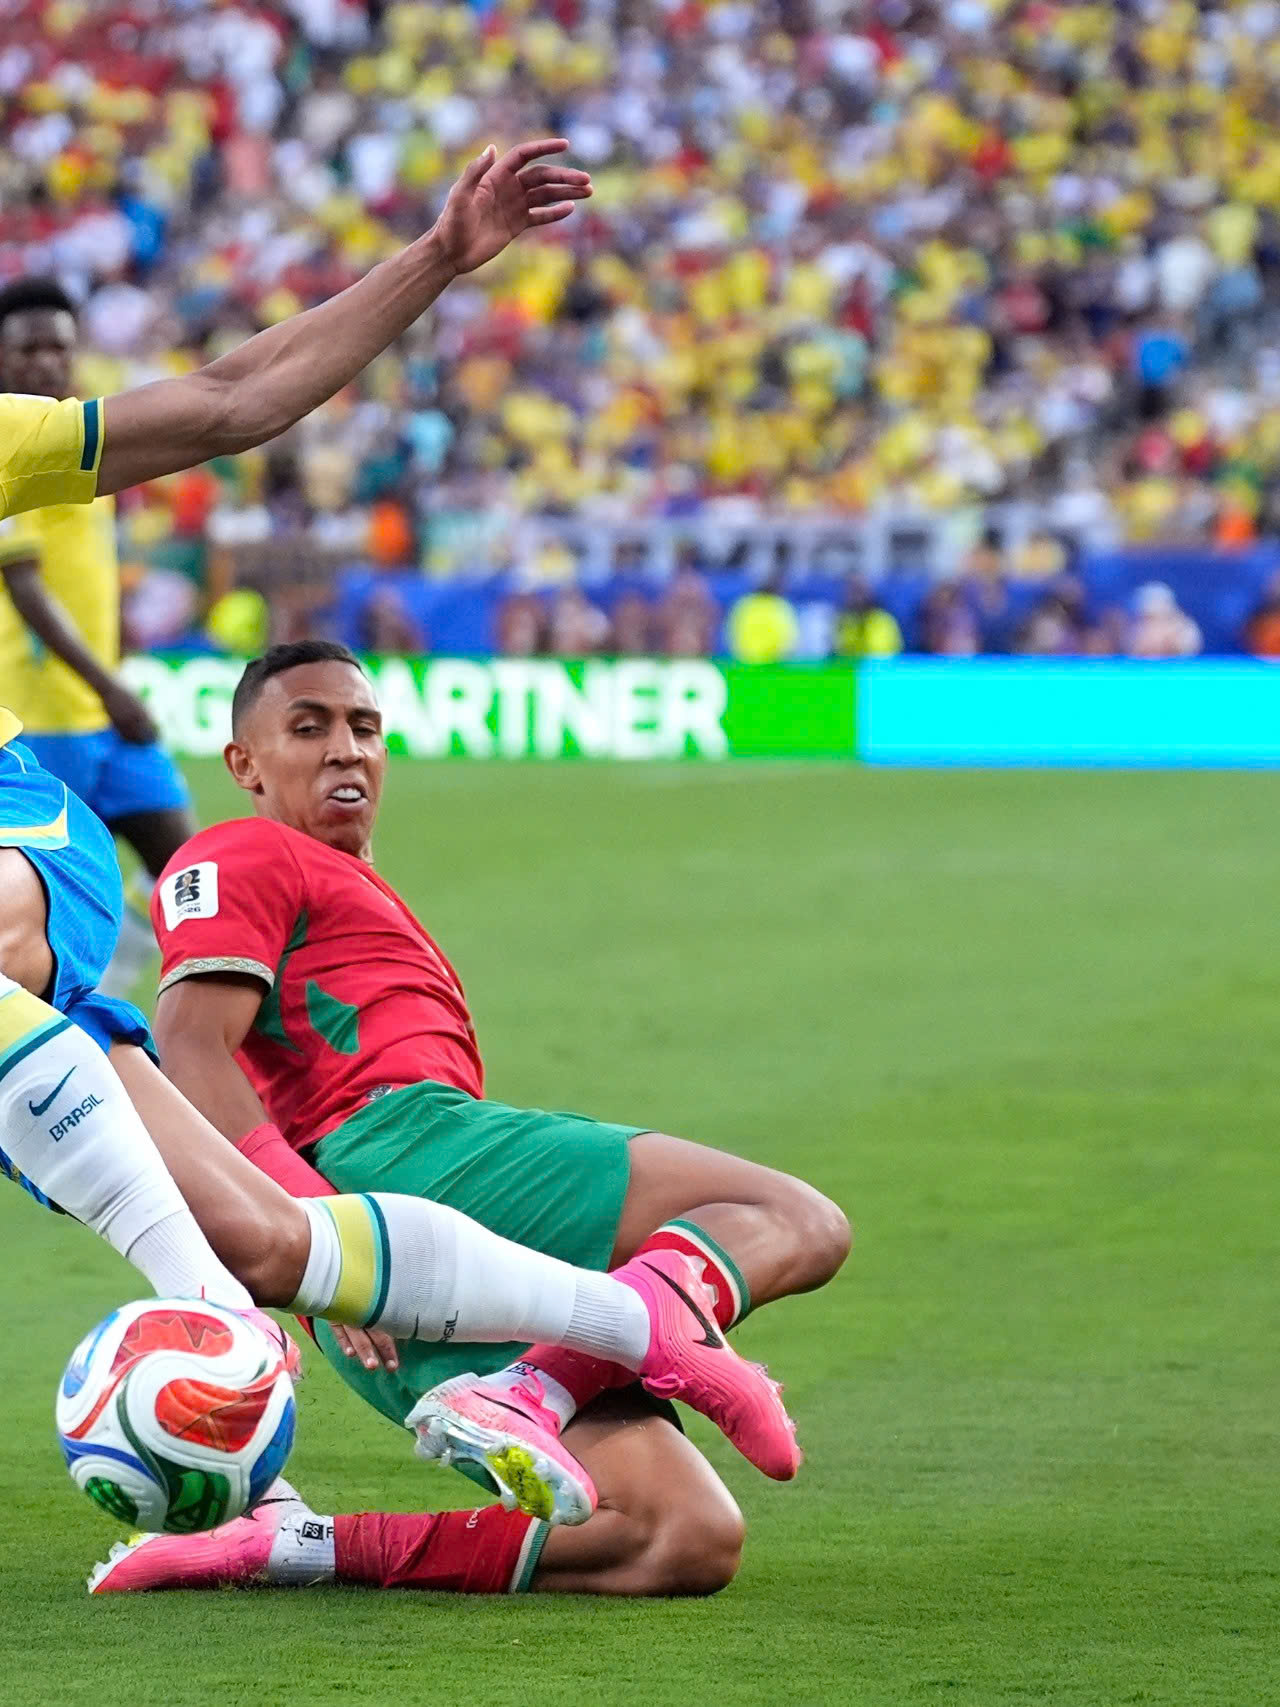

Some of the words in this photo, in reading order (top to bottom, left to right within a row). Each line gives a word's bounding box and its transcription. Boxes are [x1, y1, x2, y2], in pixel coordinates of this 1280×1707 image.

[360, 657, 728, 760] ARTNER
[49, 1094, 104, 1142] BRASIL
[303, 1523, 320, 1538] FS
